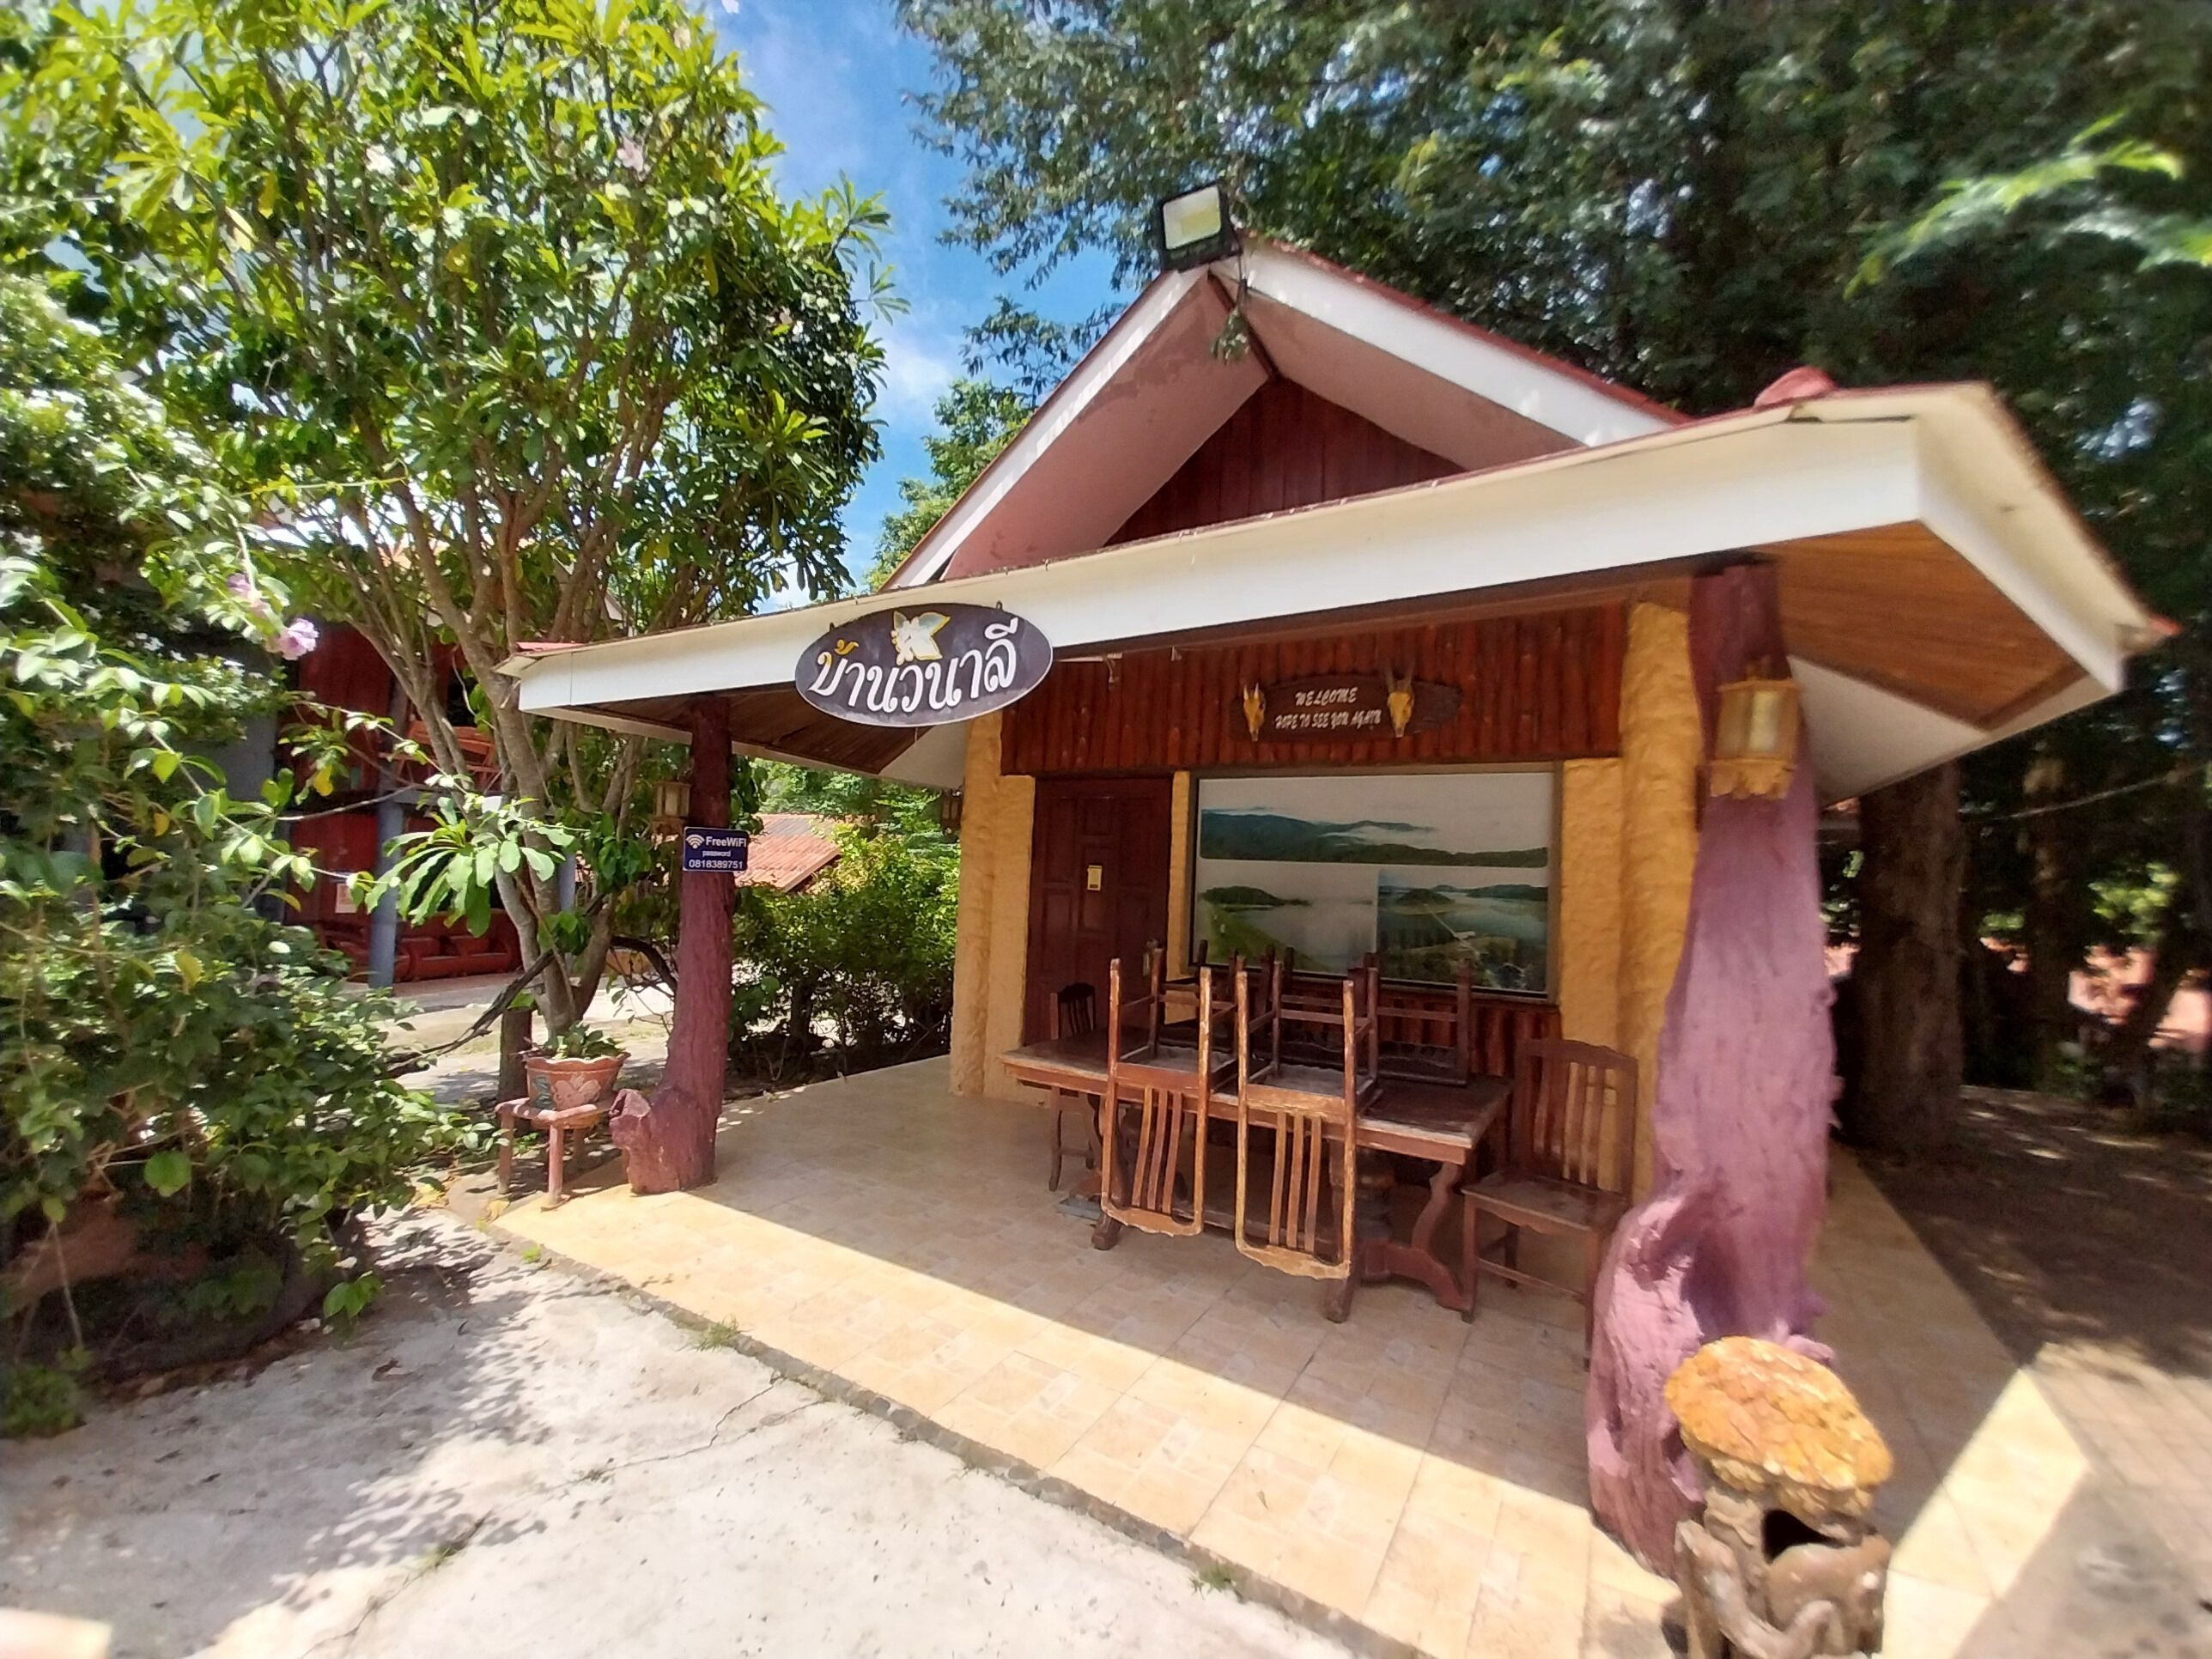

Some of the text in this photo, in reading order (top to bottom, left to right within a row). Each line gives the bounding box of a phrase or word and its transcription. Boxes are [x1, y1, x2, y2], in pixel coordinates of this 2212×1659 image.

[808, 617, 1018, 714] บ้านวนาลี
[1295, 687, 1358, 707] WELCOME
[1275, 709, 1382, 730] HOPE TO SEE YOU AGAIN
[689, 859, 744, 869] 0818389751
